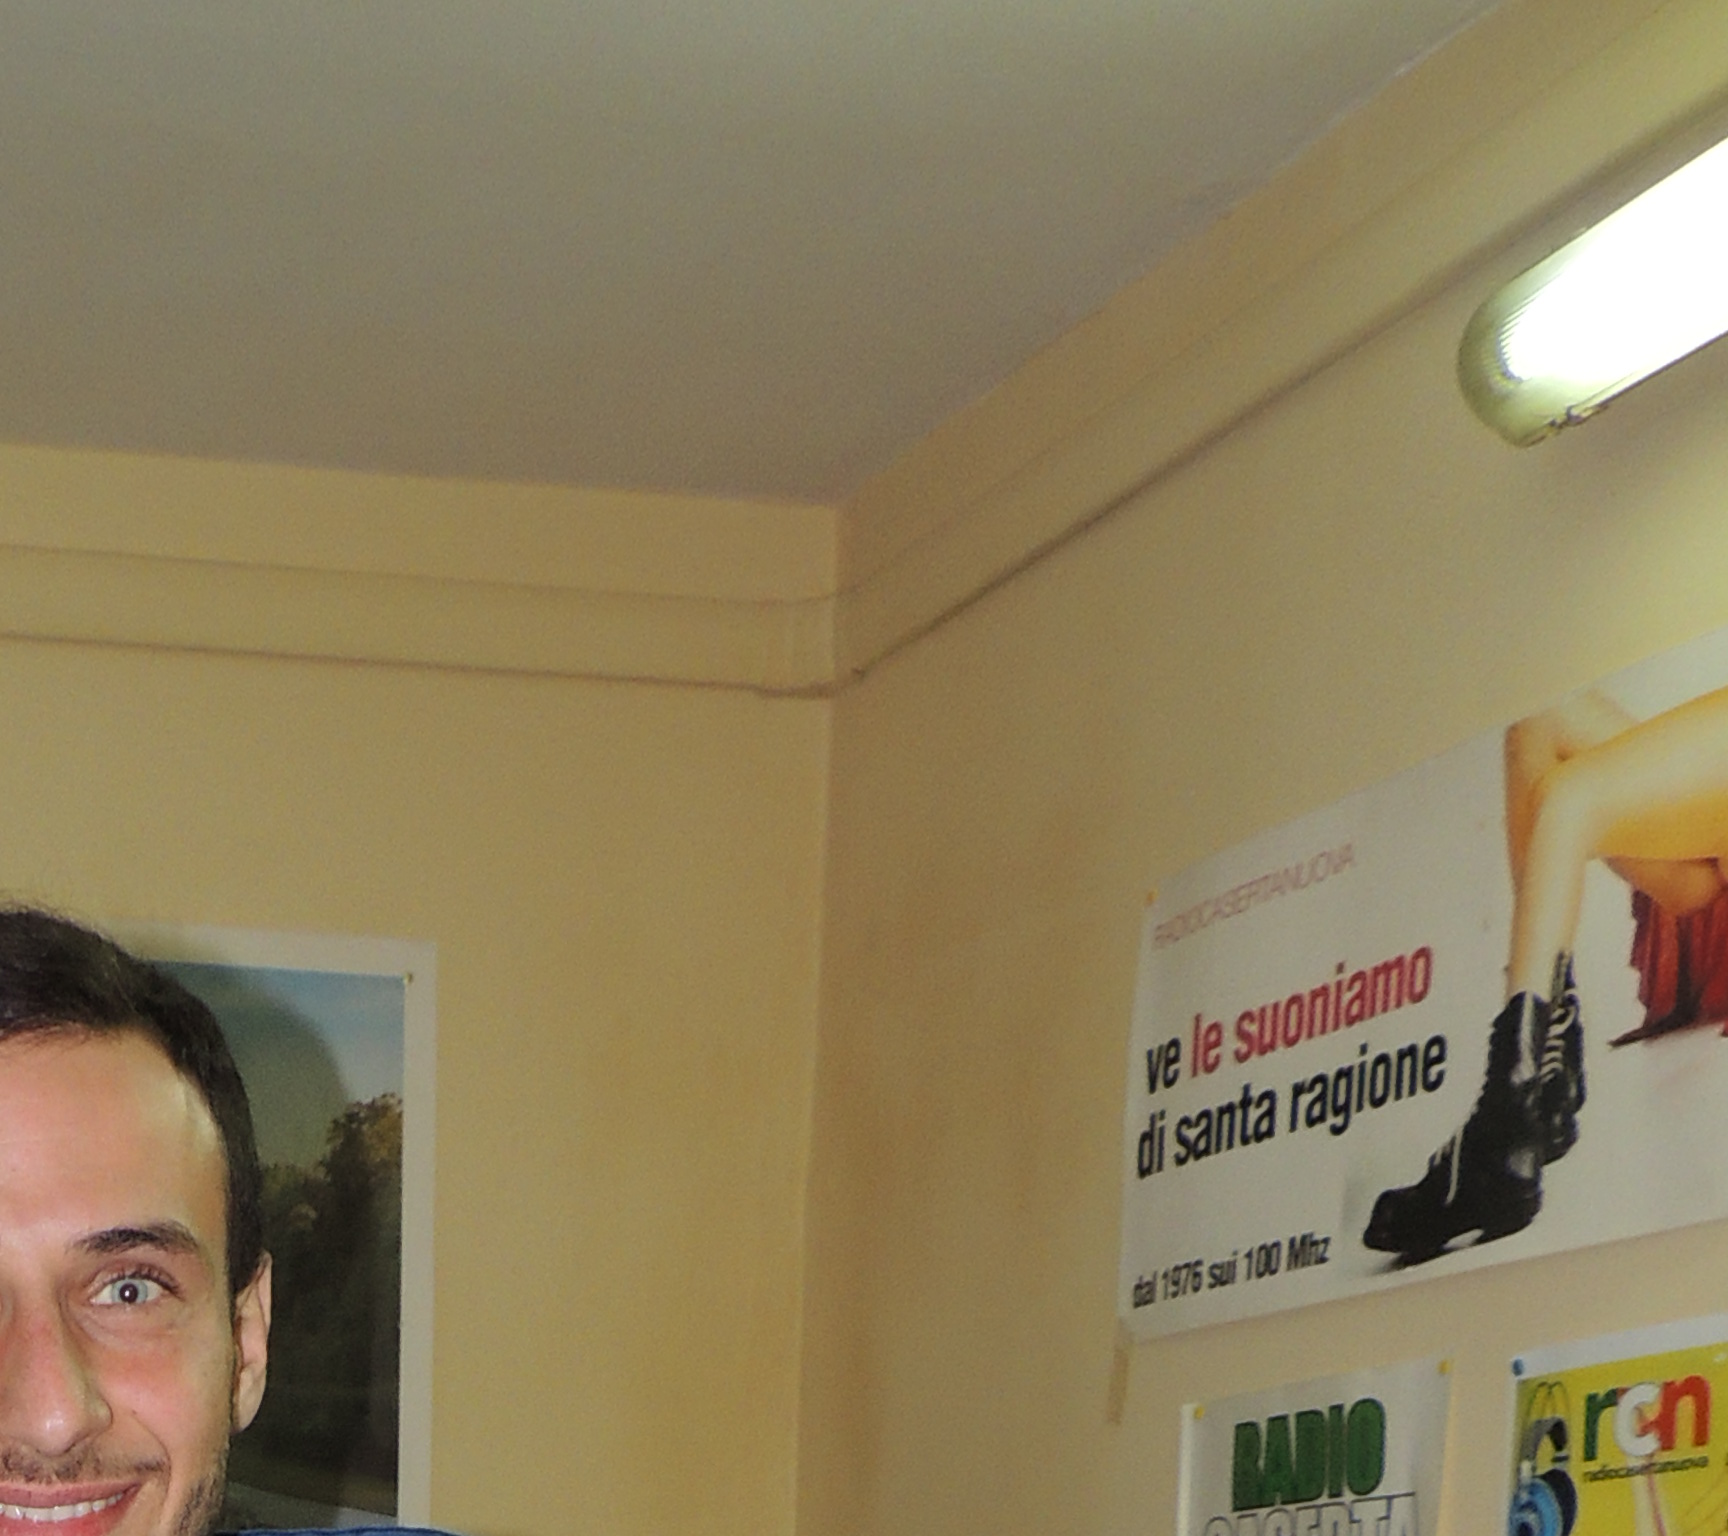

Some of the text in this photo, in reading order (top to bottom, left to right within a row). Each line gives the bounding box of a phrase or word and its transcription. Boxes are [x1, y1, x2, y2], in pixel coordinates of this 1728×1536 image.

[1147, 945, 1434, 1094] ve le suoniamo
[1137, 1033, 1448, 1179] di santa ragione
[1133, 1231, 1332, 1309] dal 1976 sui 100 Mhz
[1232, 1397, 1387, 1512] RADIO
[1583, 1374, 1710, 1462] rcn
